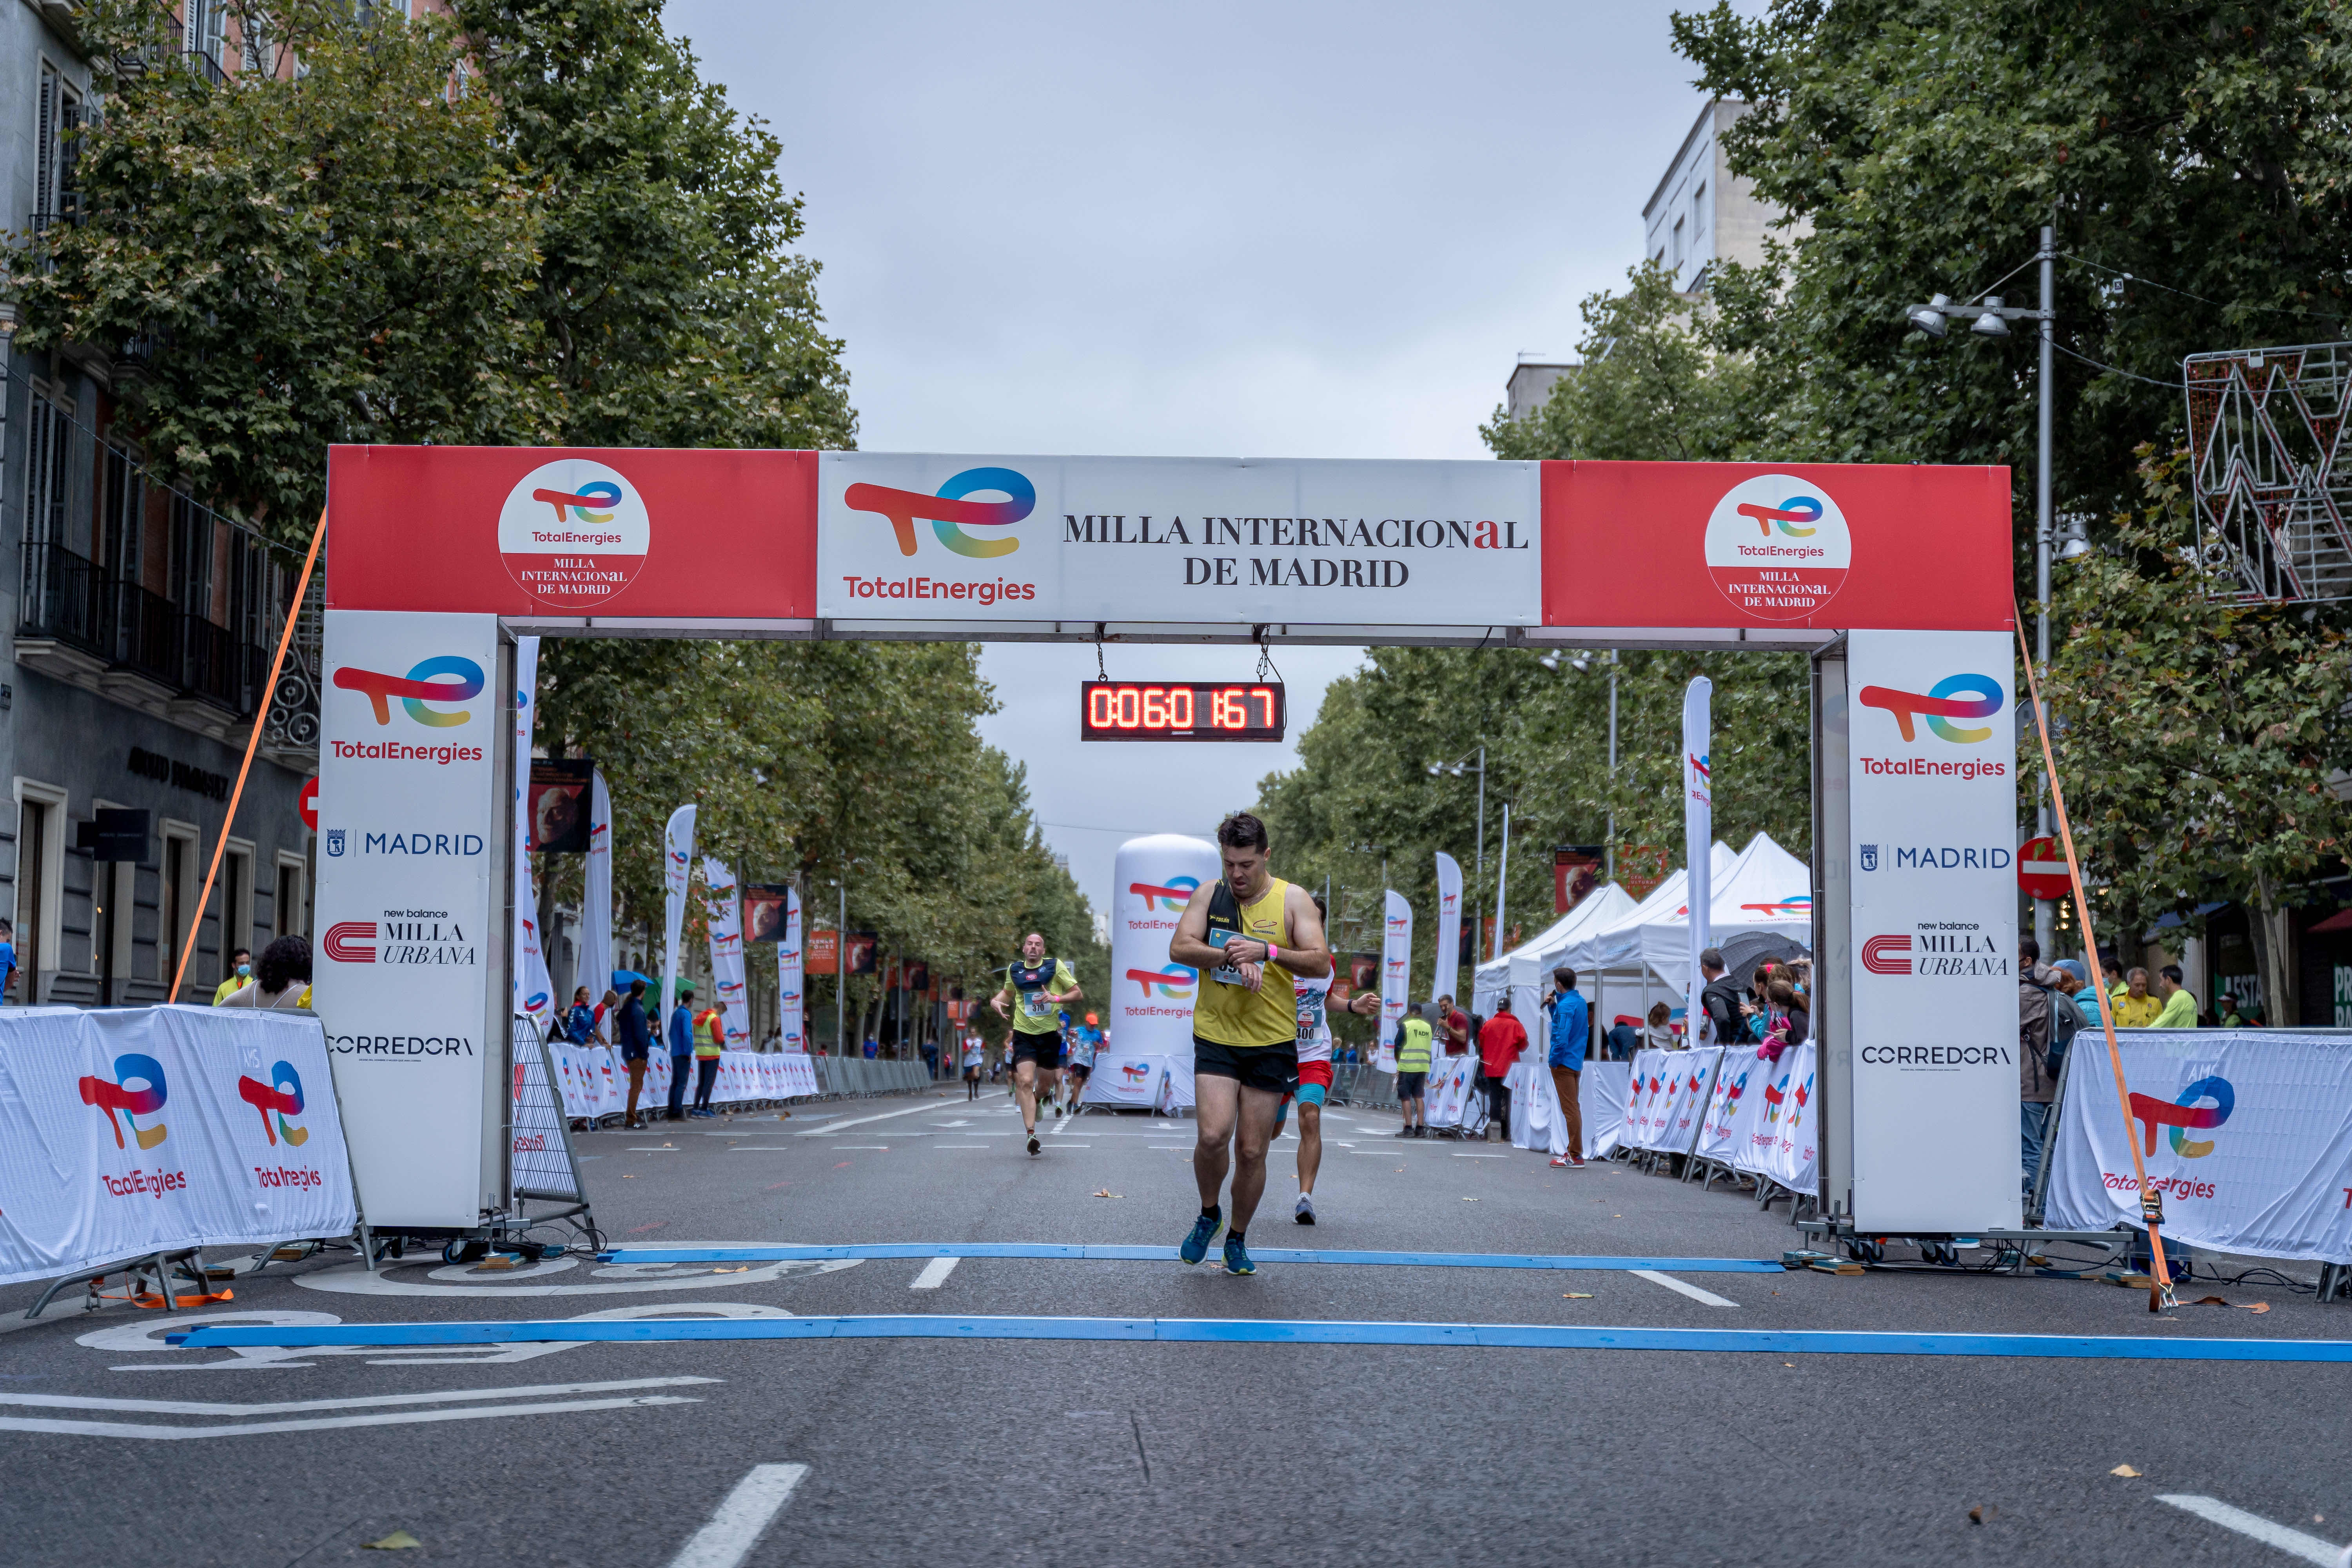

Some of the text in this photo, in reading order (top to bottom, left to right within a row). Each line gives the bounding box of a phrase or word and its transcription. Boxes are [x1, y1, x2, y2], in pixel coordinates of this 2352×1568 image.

[532, 532, 621, 545] TotalEnergies
[1063, 515, 1189, 544] MILLA
[1738, 545, 1824, 559] TotalEnergies
[554, 558, 595, 568] MILLA
[1183, 557, 1408, 588] DE MADRID
[1760, 572, 1800, 581] MILLA
[537, 584, 611, 595] DE MADRID
[843, 576, 1035, 606] TotalEnergies
[1744, 597, 1815, 607] DE MADRID
[330, 740, 482, 765] TotalEnergies
[1860, 758, 2005, 780] TotalEnergies
[366, 833, 483, 855] MADRID
[1897, 848, 2010, 869] MADRID
[407, 909, 448, 918] balance
[384, 923, 464, 941] MILLA
[1939, 922, 1980, 930] balance
[1919, 935, 1996, 953] MILLA
[383, 946, 476, 965] URBANA
[1919, 958, 2009, 976] URBANA
